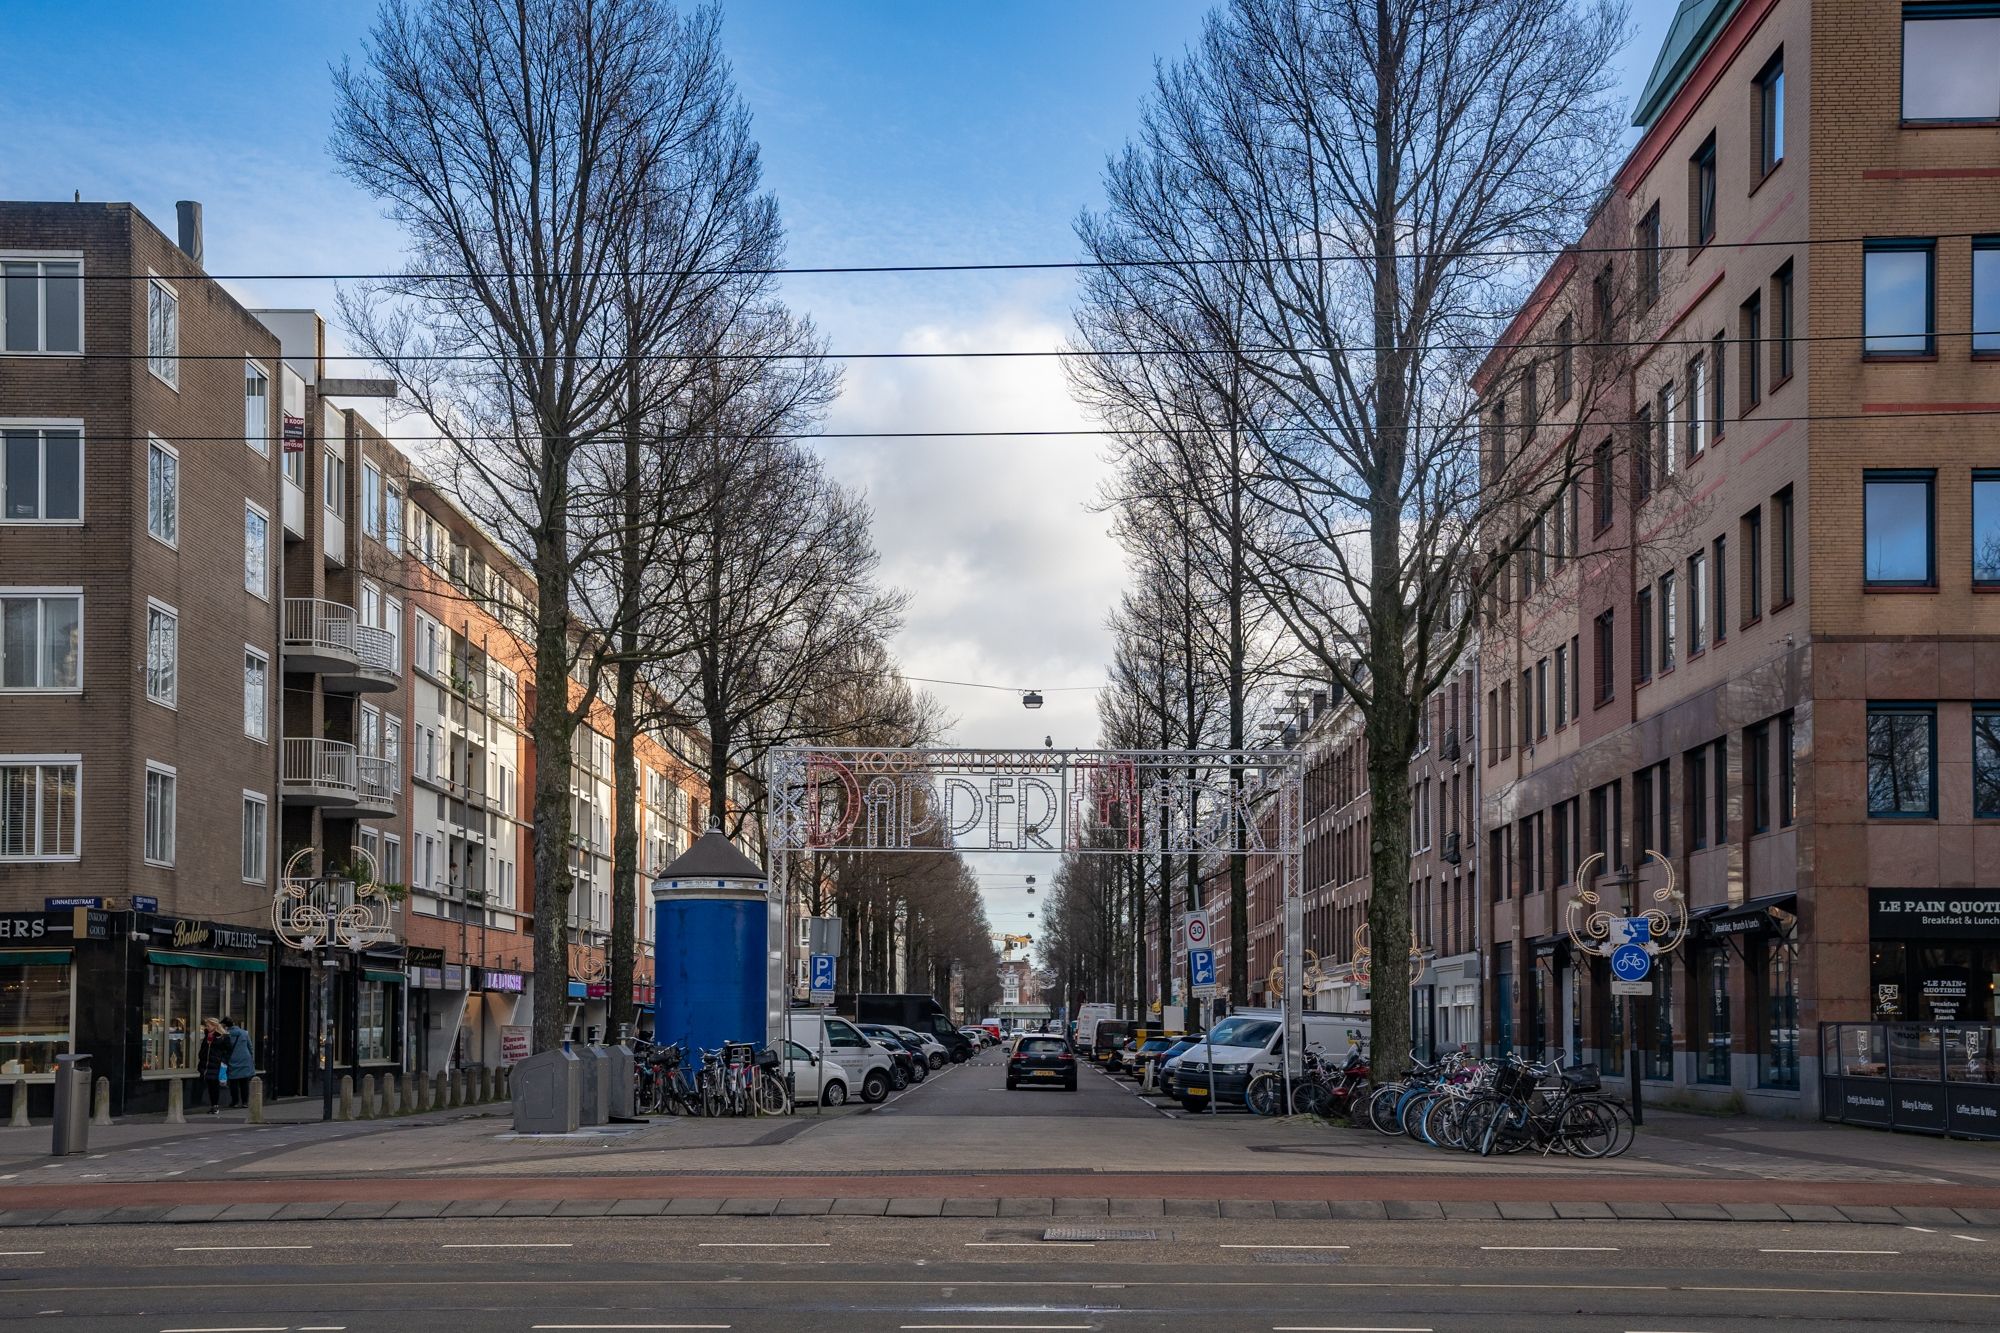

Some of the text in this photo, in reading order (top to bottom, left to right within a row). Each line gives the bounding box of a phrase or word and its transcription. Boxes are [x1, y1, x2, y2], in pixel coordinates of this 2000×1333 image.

[807, 755, 1057, 850] DAPPER
[1879, 901, 1900, 912] LE
[1904, 901, 1946, 912] PAIN
[1922, 916, 2000, 925] Breakfast & Lunch
[89, 926, 106, 936] GOUD
[1192, 926, 1202, 935] 30
[213, 929, 258, 949] JUWELIERS
[817, 958, 828, 974] P
[1196, 953, 1208, 970] P
